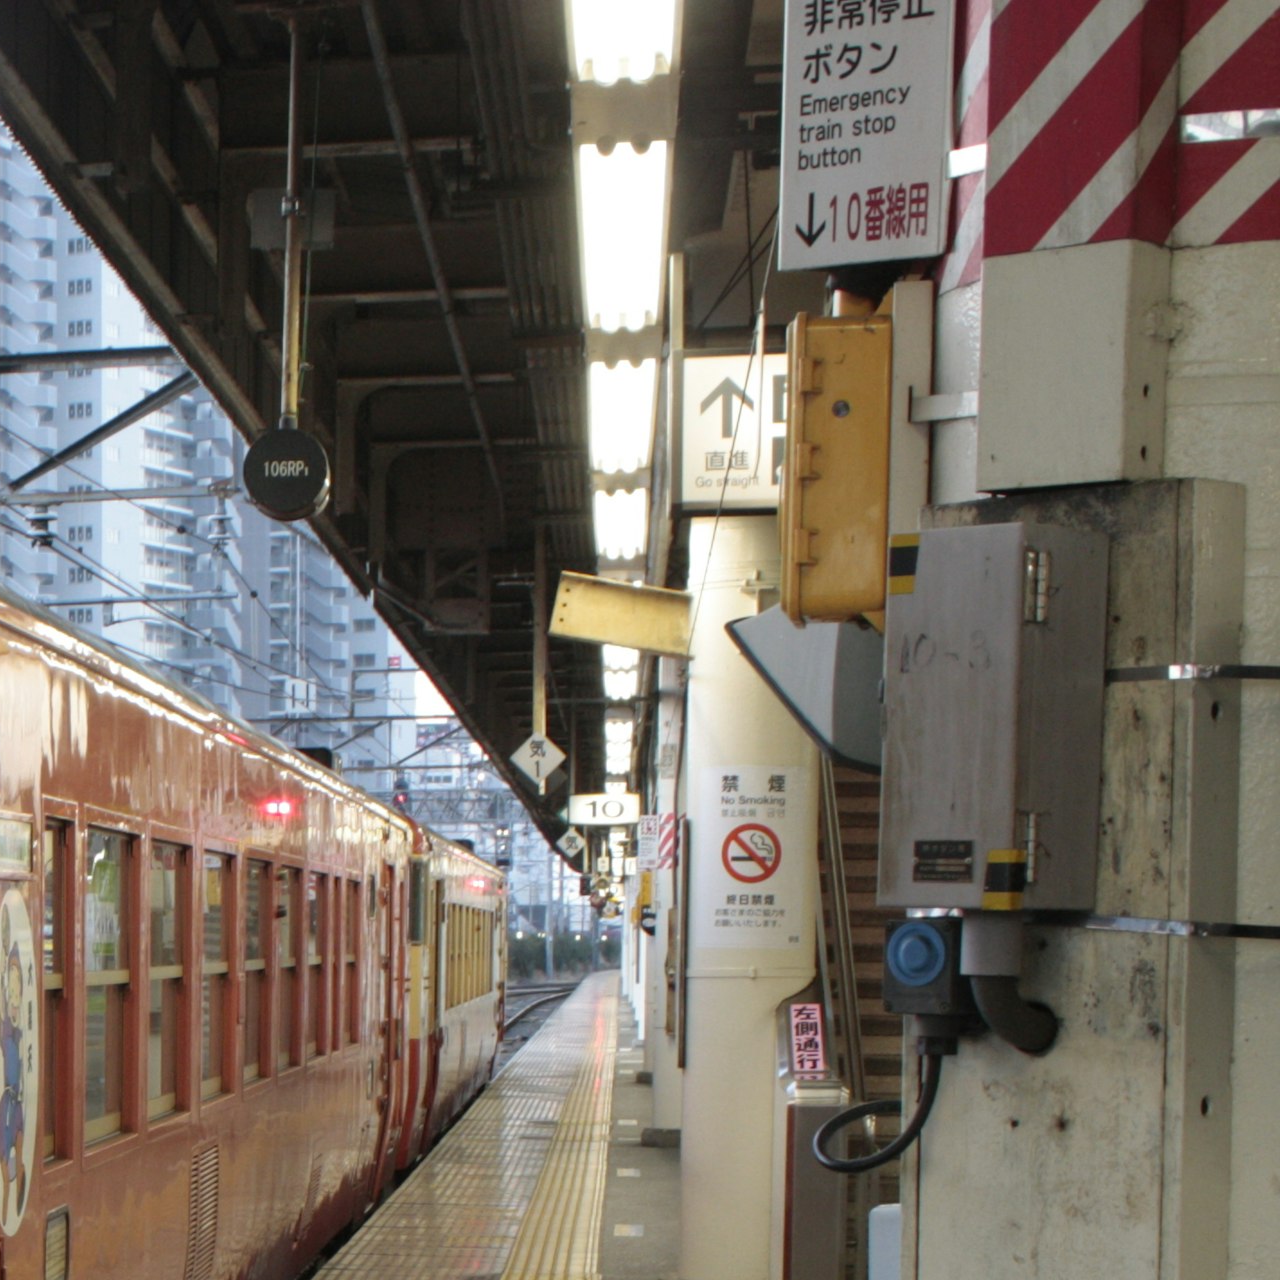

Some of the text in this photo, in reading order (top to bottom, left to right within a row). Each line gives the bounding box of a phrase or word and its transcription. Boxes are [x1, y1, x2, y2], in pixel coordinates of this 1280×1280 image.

[803, 42, 898, 84] ボタン
[799, 85, 911, 117] Emergency
[799, 115, 896, 144] train stop
[797, 146, 862, 171] button
[829, 181, 929, 243] 10番線用
[705, 451, 749, 471] 直進
[695, 475, 760, 490] Go straight
[586, 801, 625, 818] 10
[721, 795, 785, 806] No Smoking
[793, 1006, 820, 1069] 左側通行
